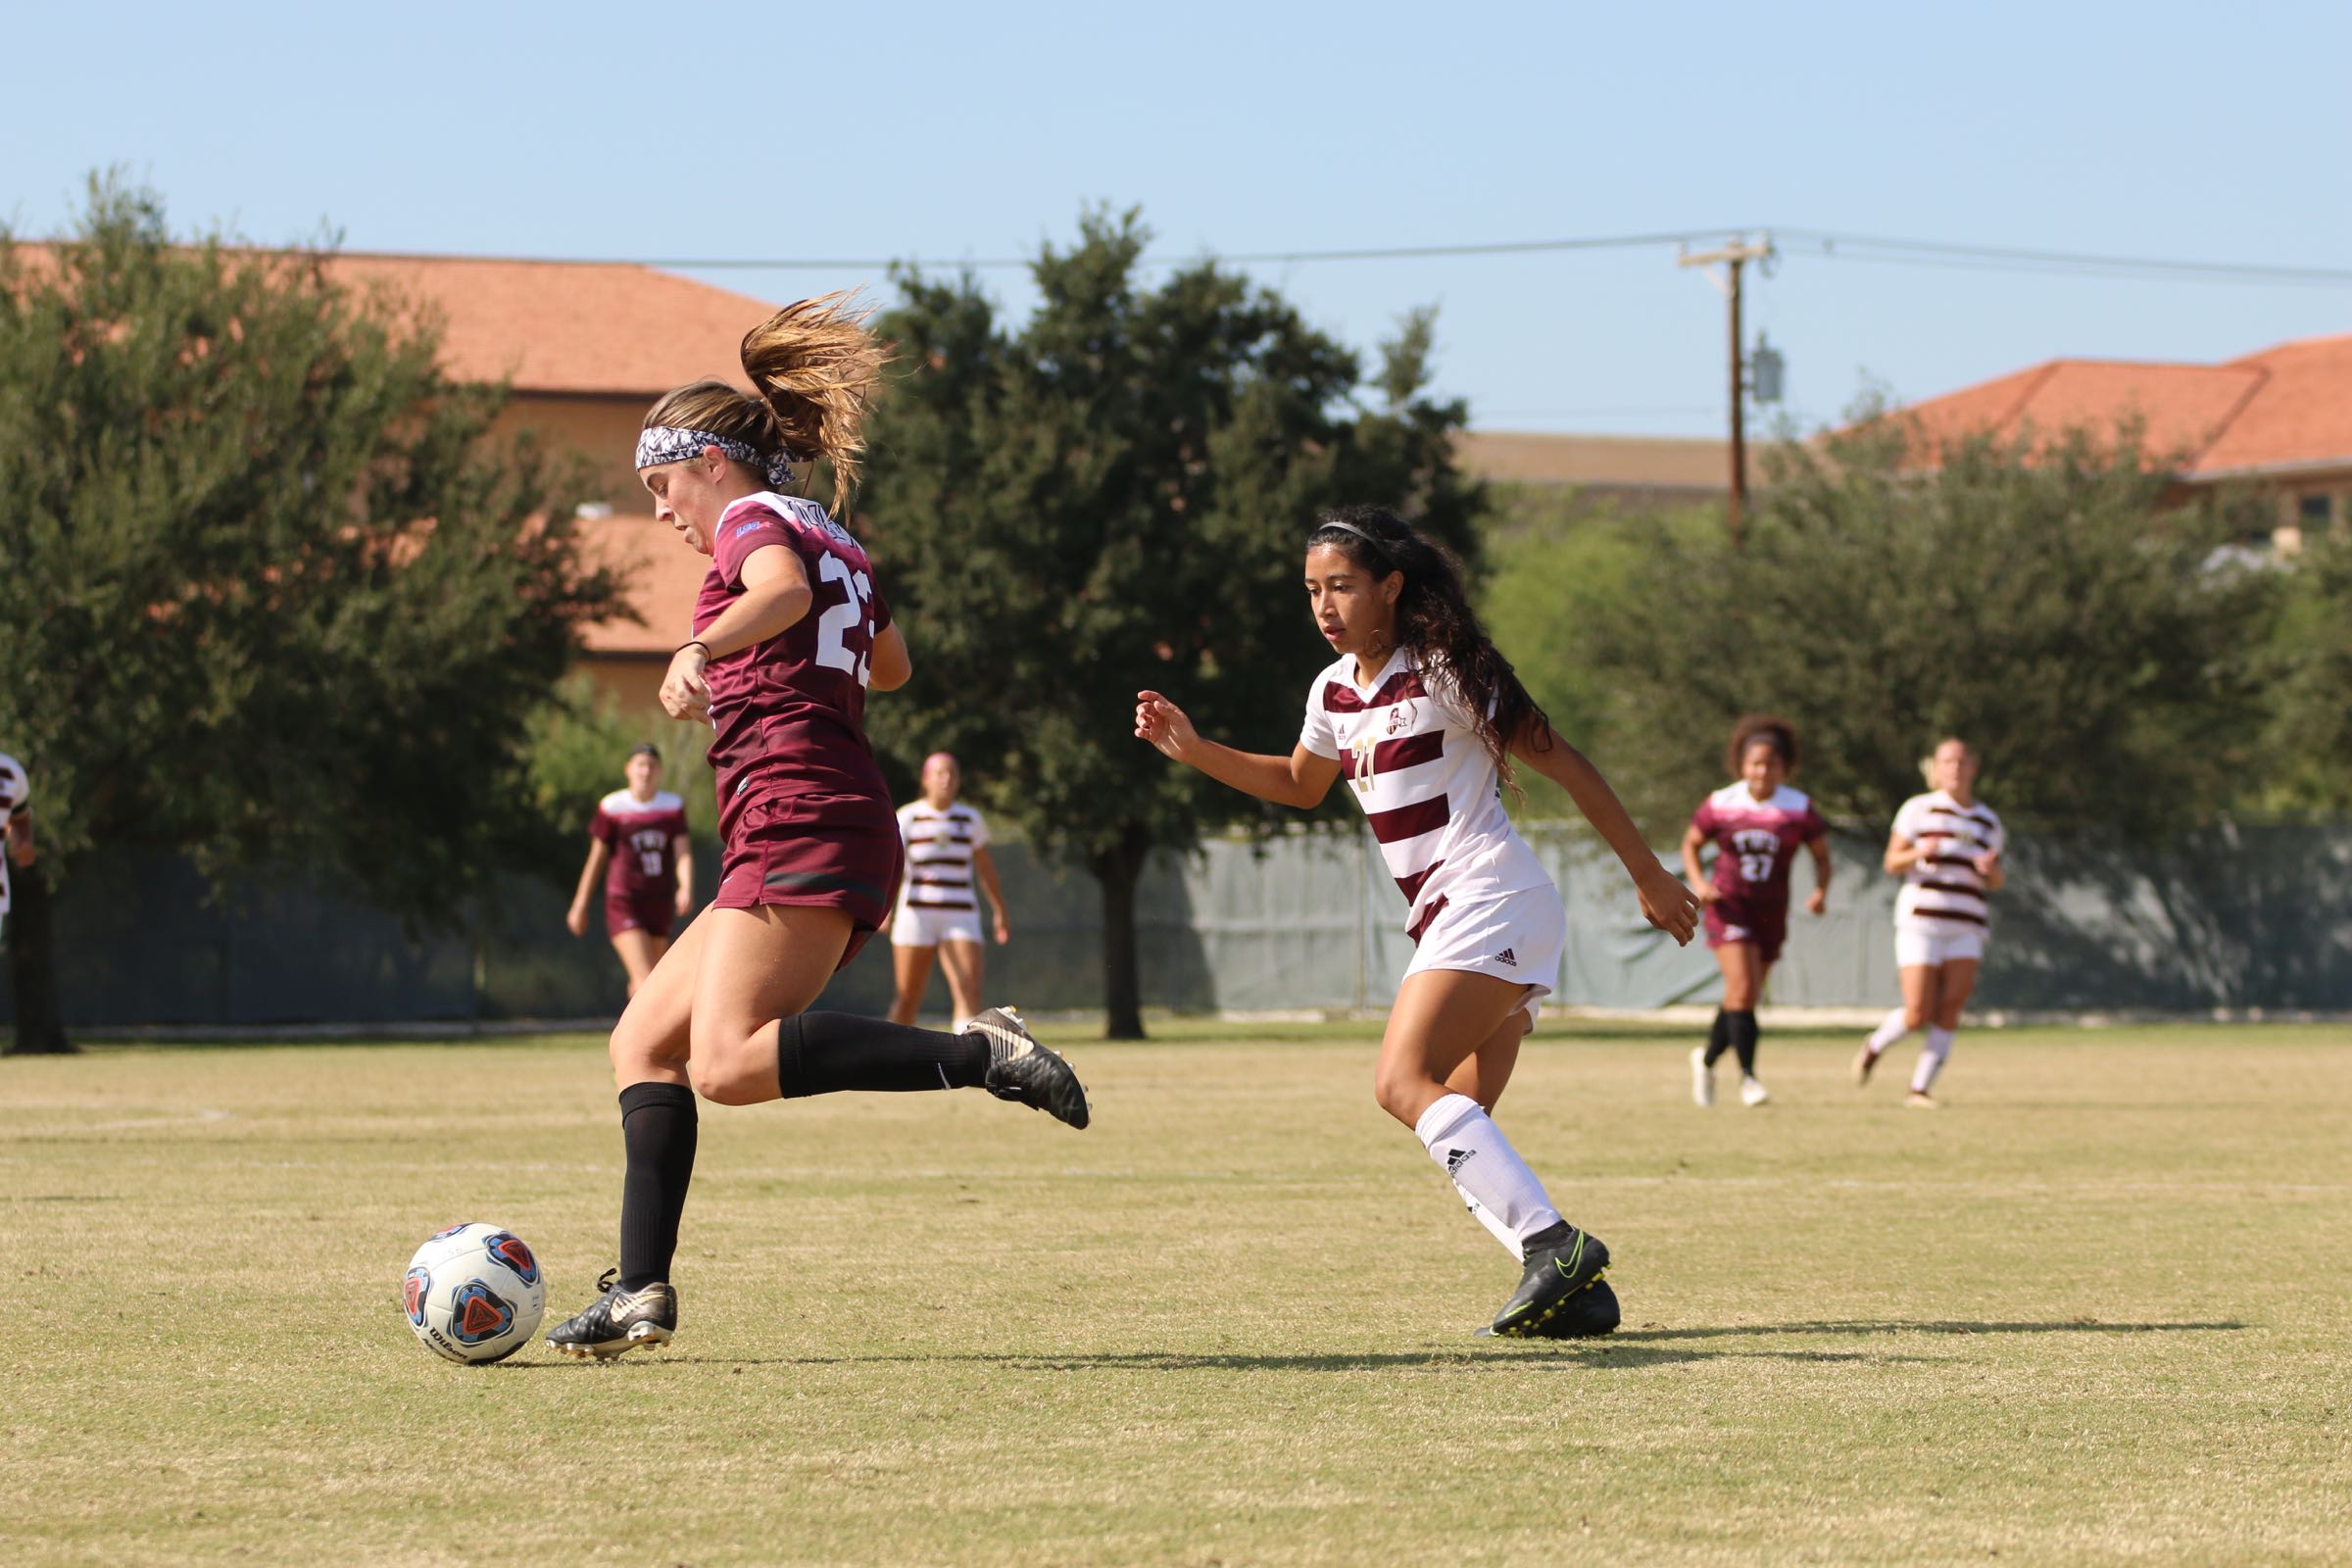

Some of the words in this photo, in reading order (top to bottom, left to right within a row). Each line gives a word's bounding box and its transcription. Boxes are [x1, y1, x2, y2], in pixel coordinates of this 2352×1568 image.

[1351, 737, 1377, 792] 21
[1740, 854, 1772, 882] 27
[1494, 956, 1517, 967] adidas
[429, 1326, 468, 1359] Wilson
